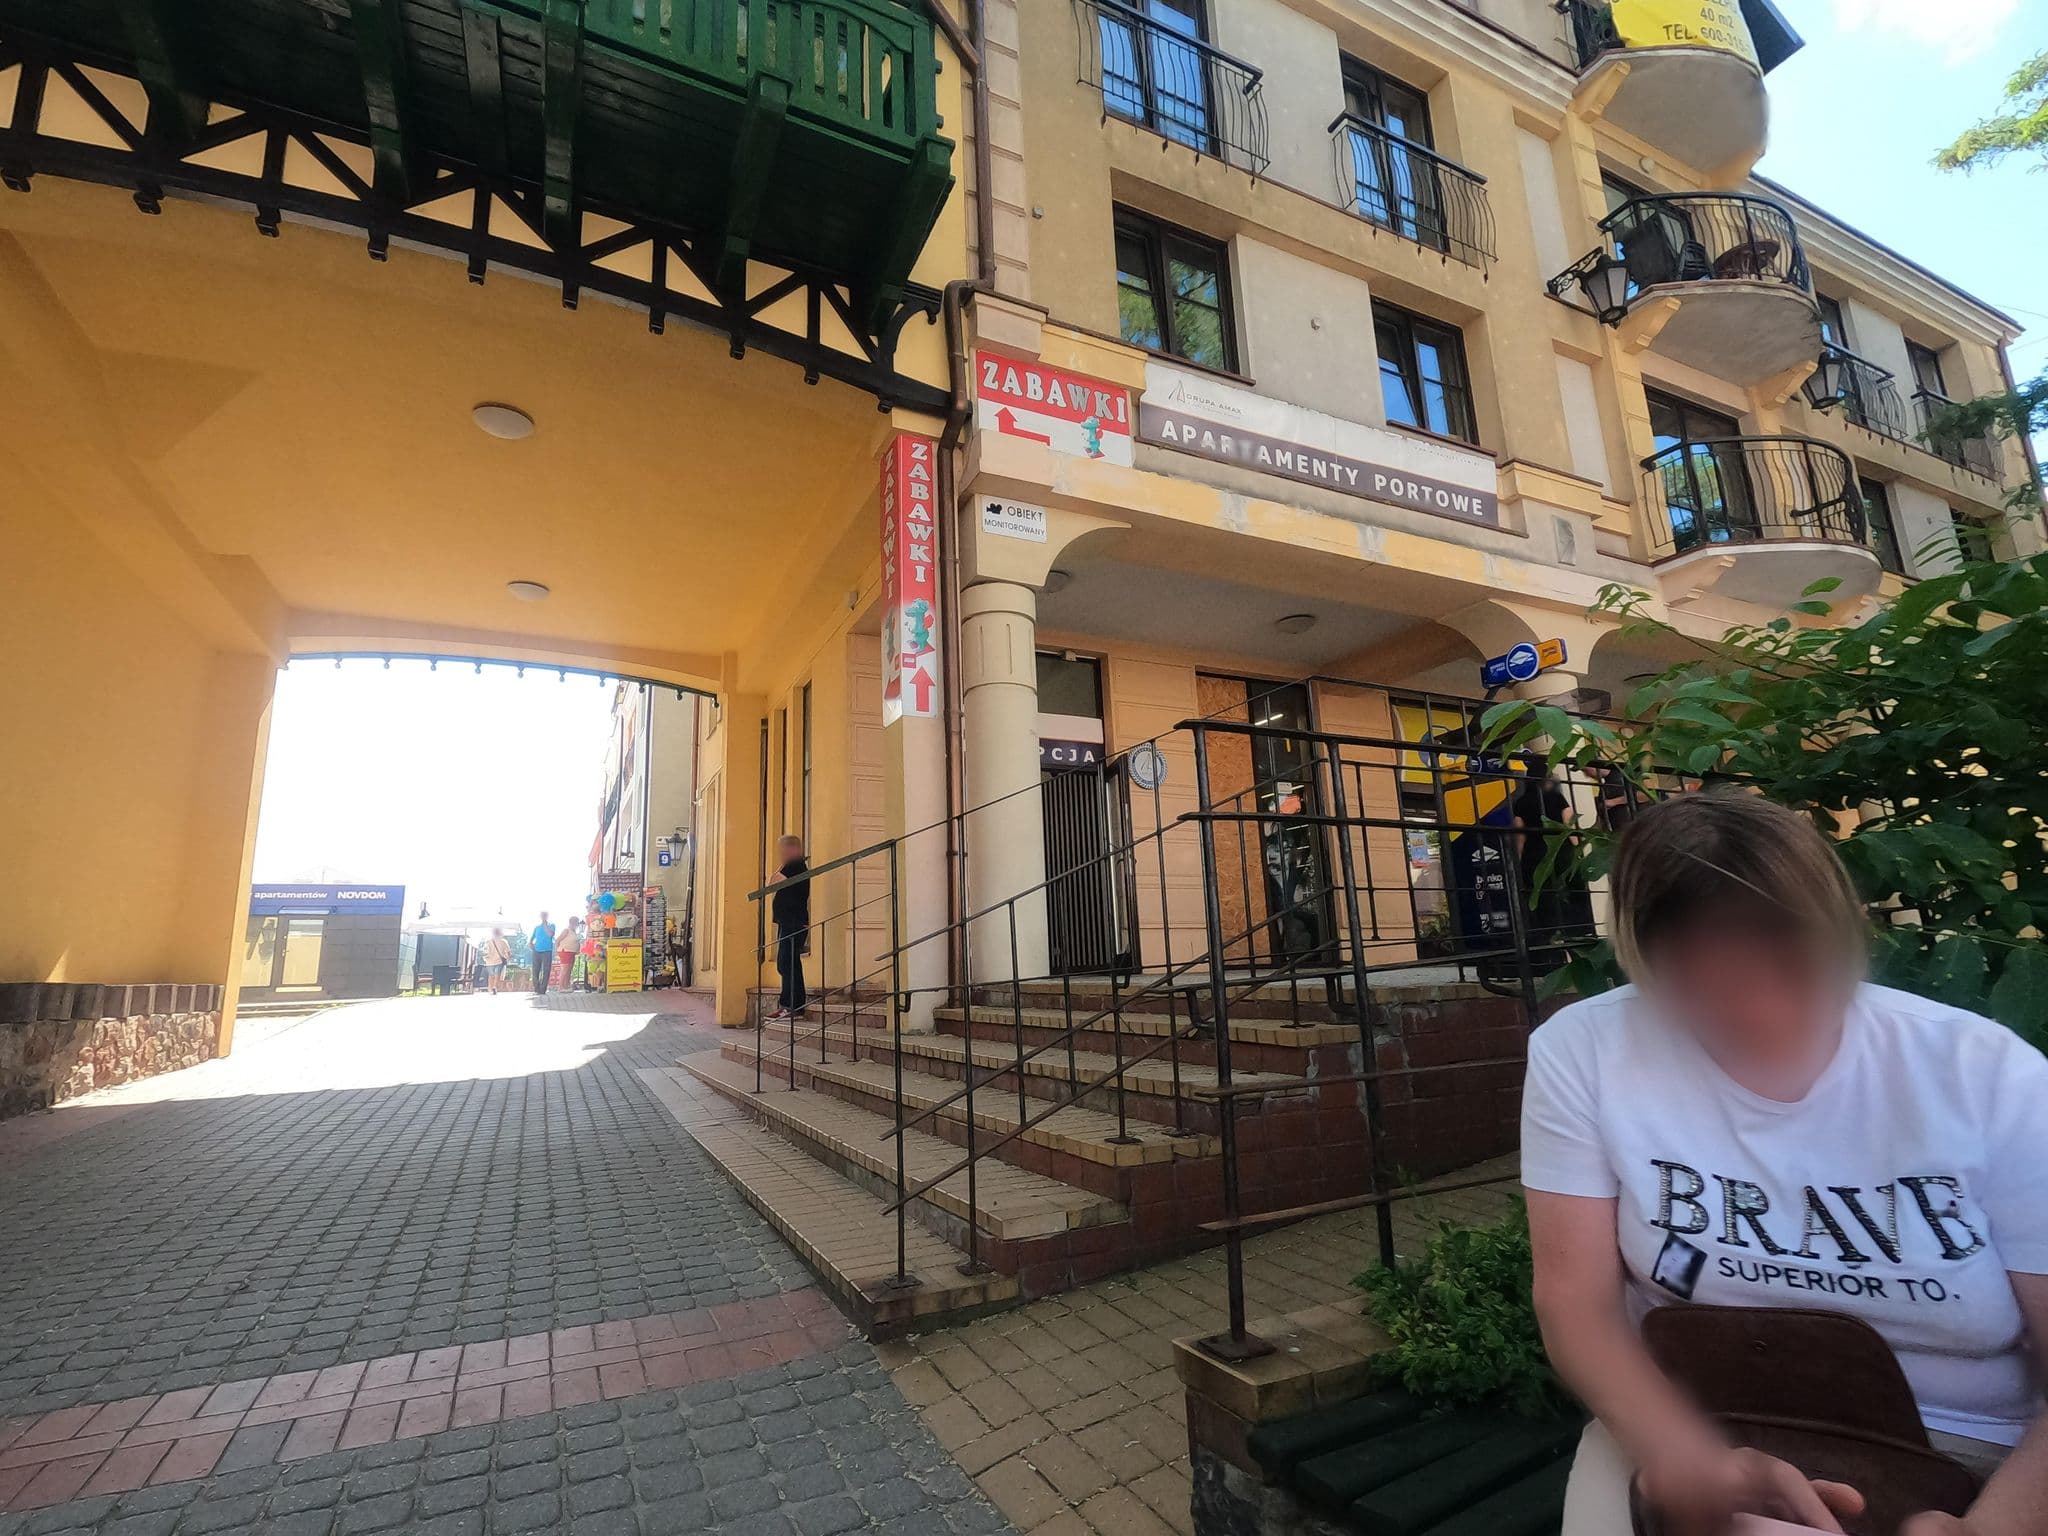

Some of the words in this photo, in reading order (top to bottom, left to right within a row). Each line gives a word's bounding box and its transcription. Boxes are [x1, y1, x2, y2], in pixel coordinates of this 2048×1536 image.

[1700, 7, 1715, 22] 40
[1662, 23, 1698, 41] TEL.
[982, 360, 1128, 424] ZABAWKI
[1374, 473, 1485, 518] PORTOWE
[905, 441, 934, 584] ZABAWKI
[1007, 505, 1043, 522] OBIEKT
[984, 518, 1046, 536] MONITOROWANY
[660, 854, 669, 865] 9
[254, 890, 328, 900] apartamentów
[337, 890, 387, 900] NOVDOM
[1649, 1158, 1987, 1264] BRAVE
[1717, 1256, 1889, 1299] SUPERIOR
